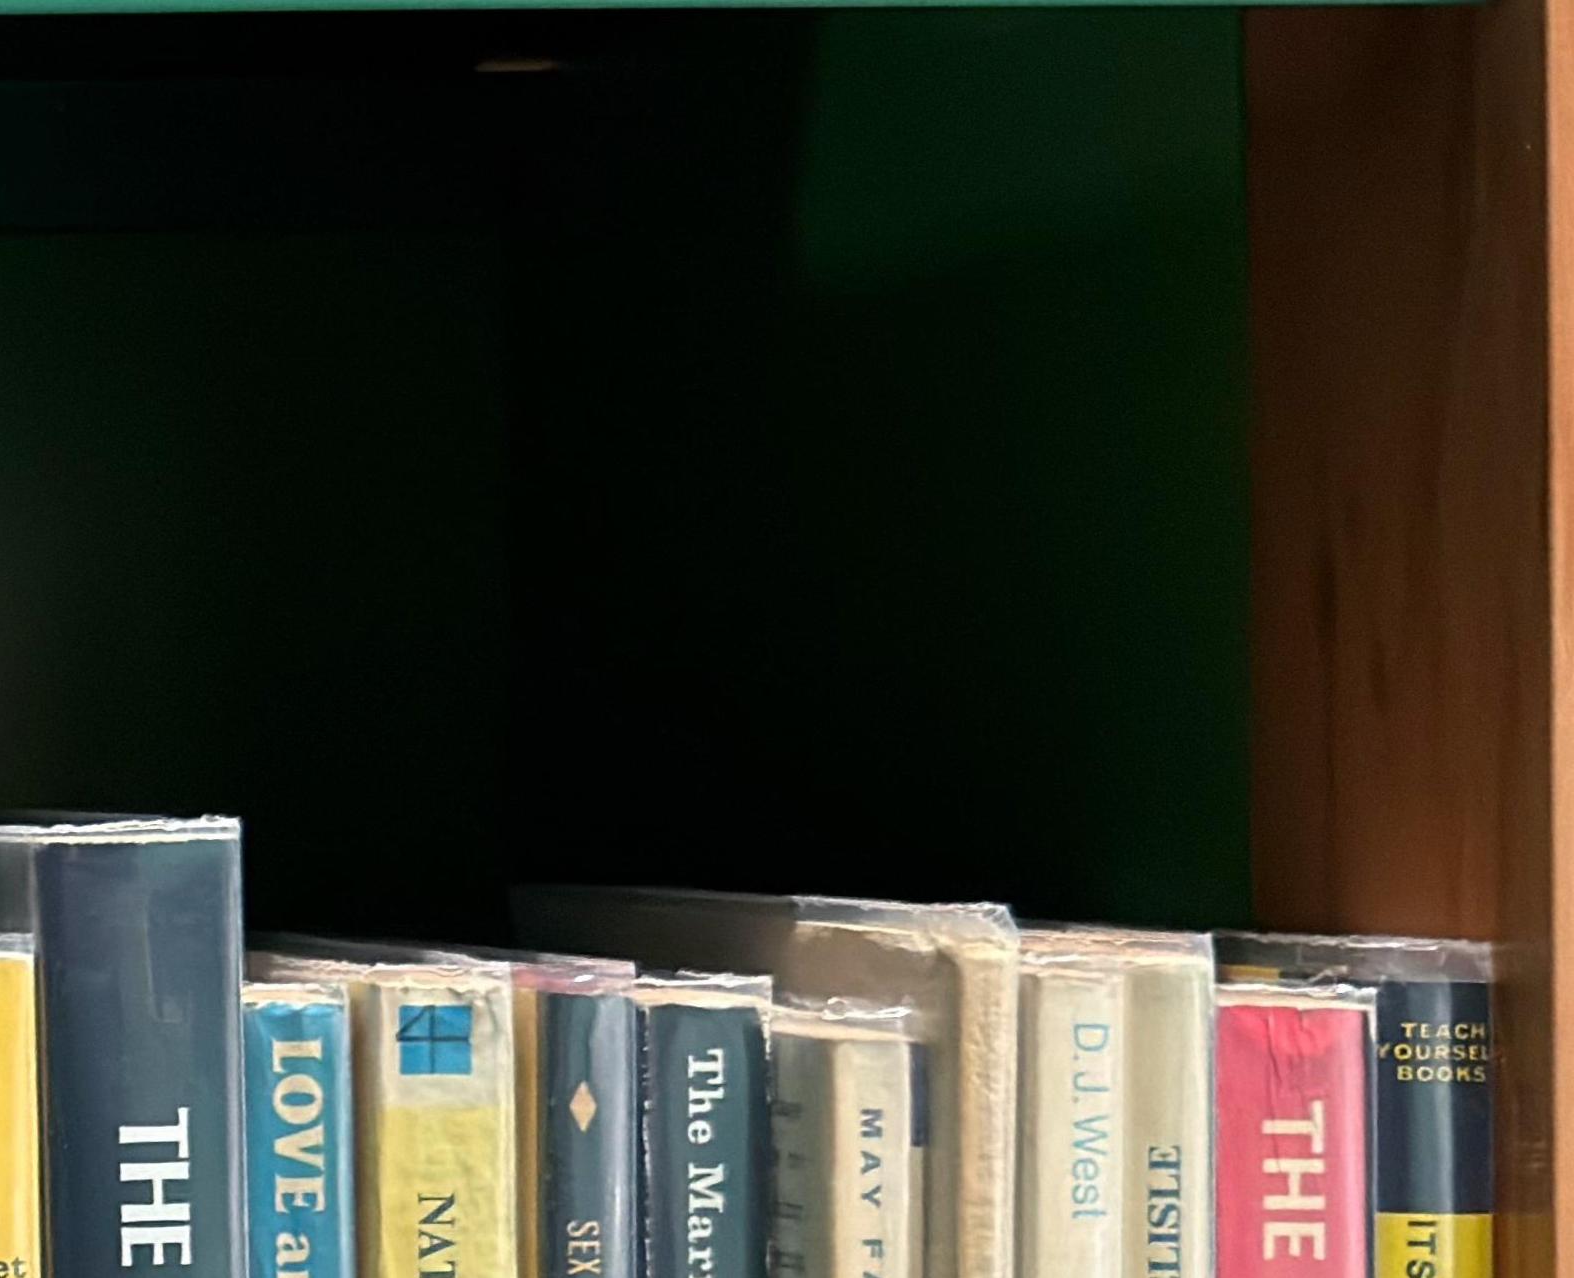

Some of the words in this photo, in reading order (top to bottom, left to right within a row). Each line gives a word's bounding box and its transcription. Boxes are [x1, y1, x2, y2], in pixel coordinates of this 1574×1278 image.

[1397, 1065, 1486, 1082] BOOKS
[1400, 1022, 1485, 1040] TEACH
[270, 1037, 325, 1213] LOVE
[686, 1048, 723, 1146] The
[119, 1107, 192, 1268] THE
[1262, 1101, 1324, 1262] THE
